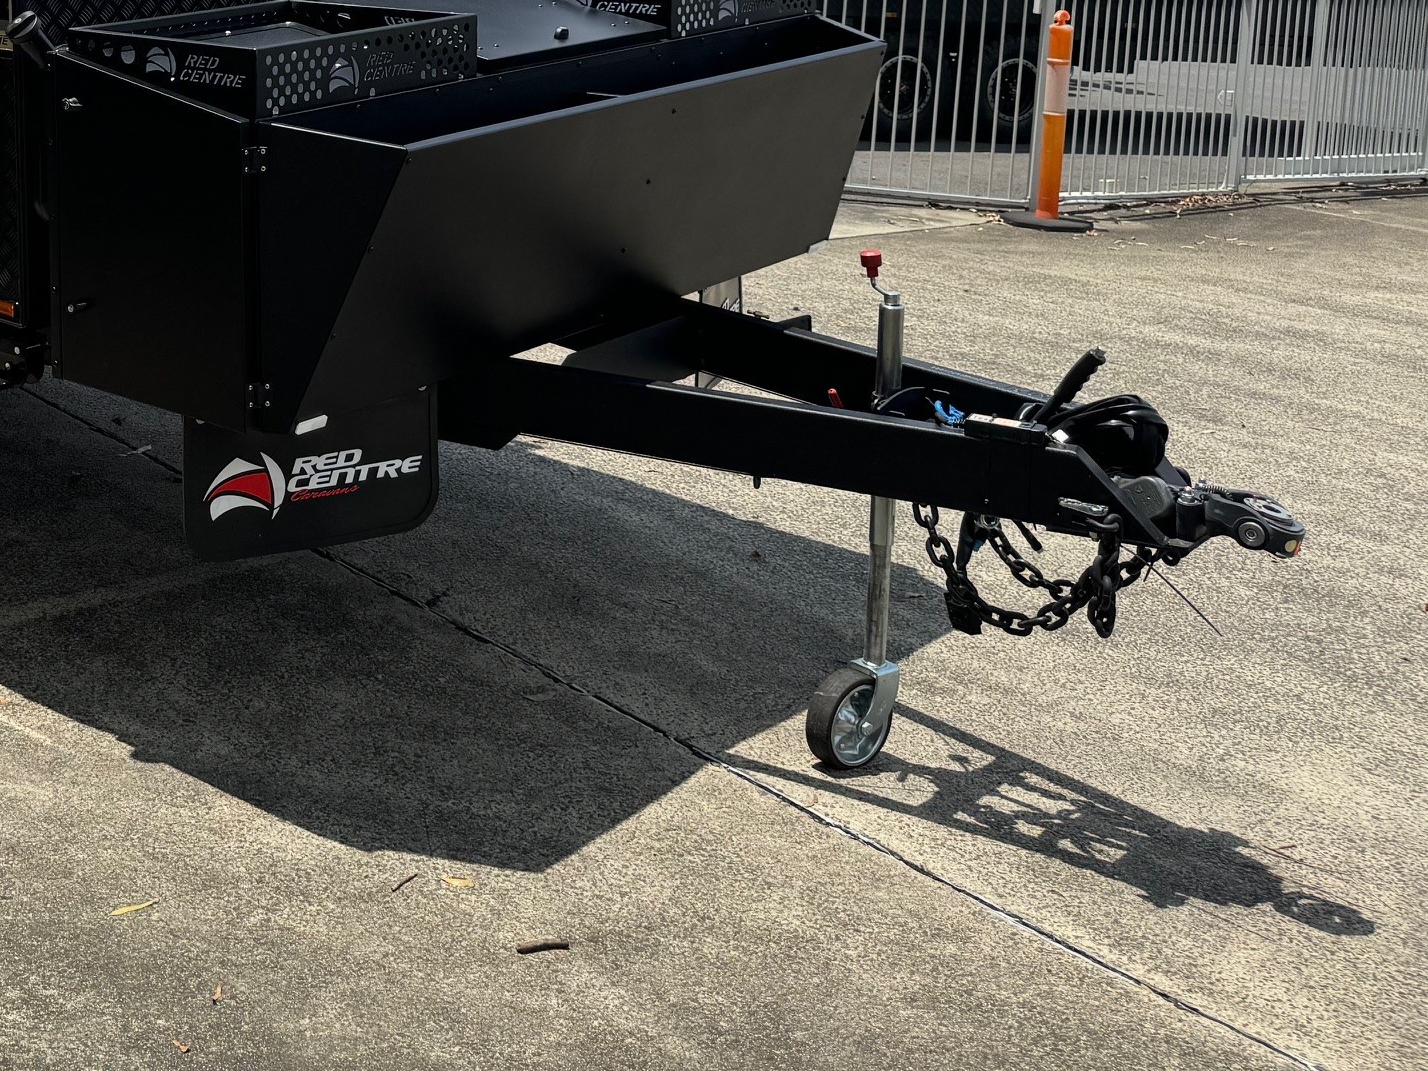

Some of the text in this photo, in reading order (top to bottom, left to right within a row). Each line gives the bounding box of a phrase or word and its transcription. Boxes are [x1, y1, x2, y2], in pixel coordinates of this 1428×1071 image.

[596, 1, 662, 16] CENTRE
[184, 54, 221, 70] RED
[366, 50, 395, 67] RED
[179, 70, 247, 89] CENTRE
[363, 60, 417, 82] CENTRE
[291, 448, 363, 475] RED
[287, 454, 424, 492] CENTRE
[290, 484, 361, 502] Caravans
